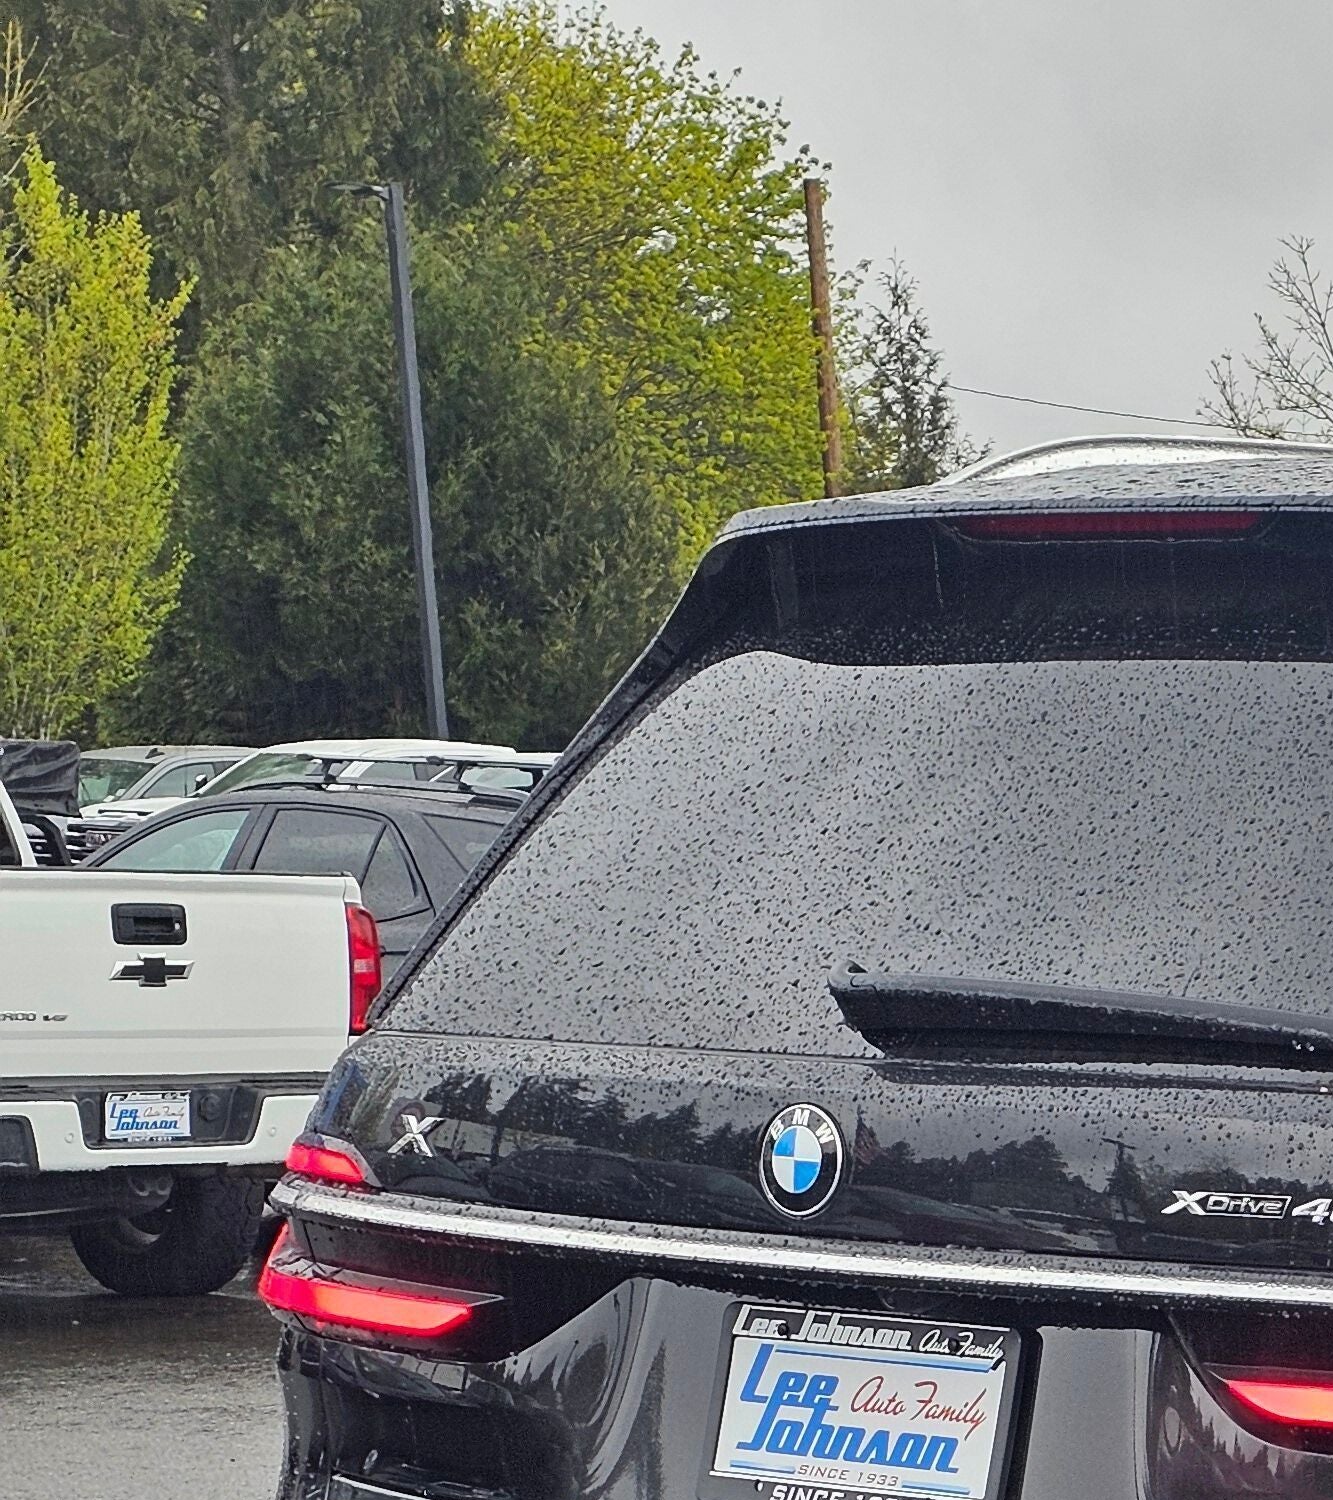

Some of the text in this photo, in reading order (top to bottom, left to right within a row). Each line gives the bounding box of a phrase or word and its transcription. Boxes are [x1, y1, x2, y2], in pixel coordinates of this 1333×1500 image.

[109, 1102, 140, 1118] Lee
[769, 1108, 836, 1144] BMW
[387, 1113, 447, 1158] X
[789, 1309, 913, 1351] Johnson
[919, 1328, 956, 1354] Aut
[956, 1331, 1004, 1370] Family
[739, 1343, 987, 1441] Lee Auto Family
[735, 1400, 960, 1474] Johnson
[797, 1464, 899, 1487] SINCE 1933
